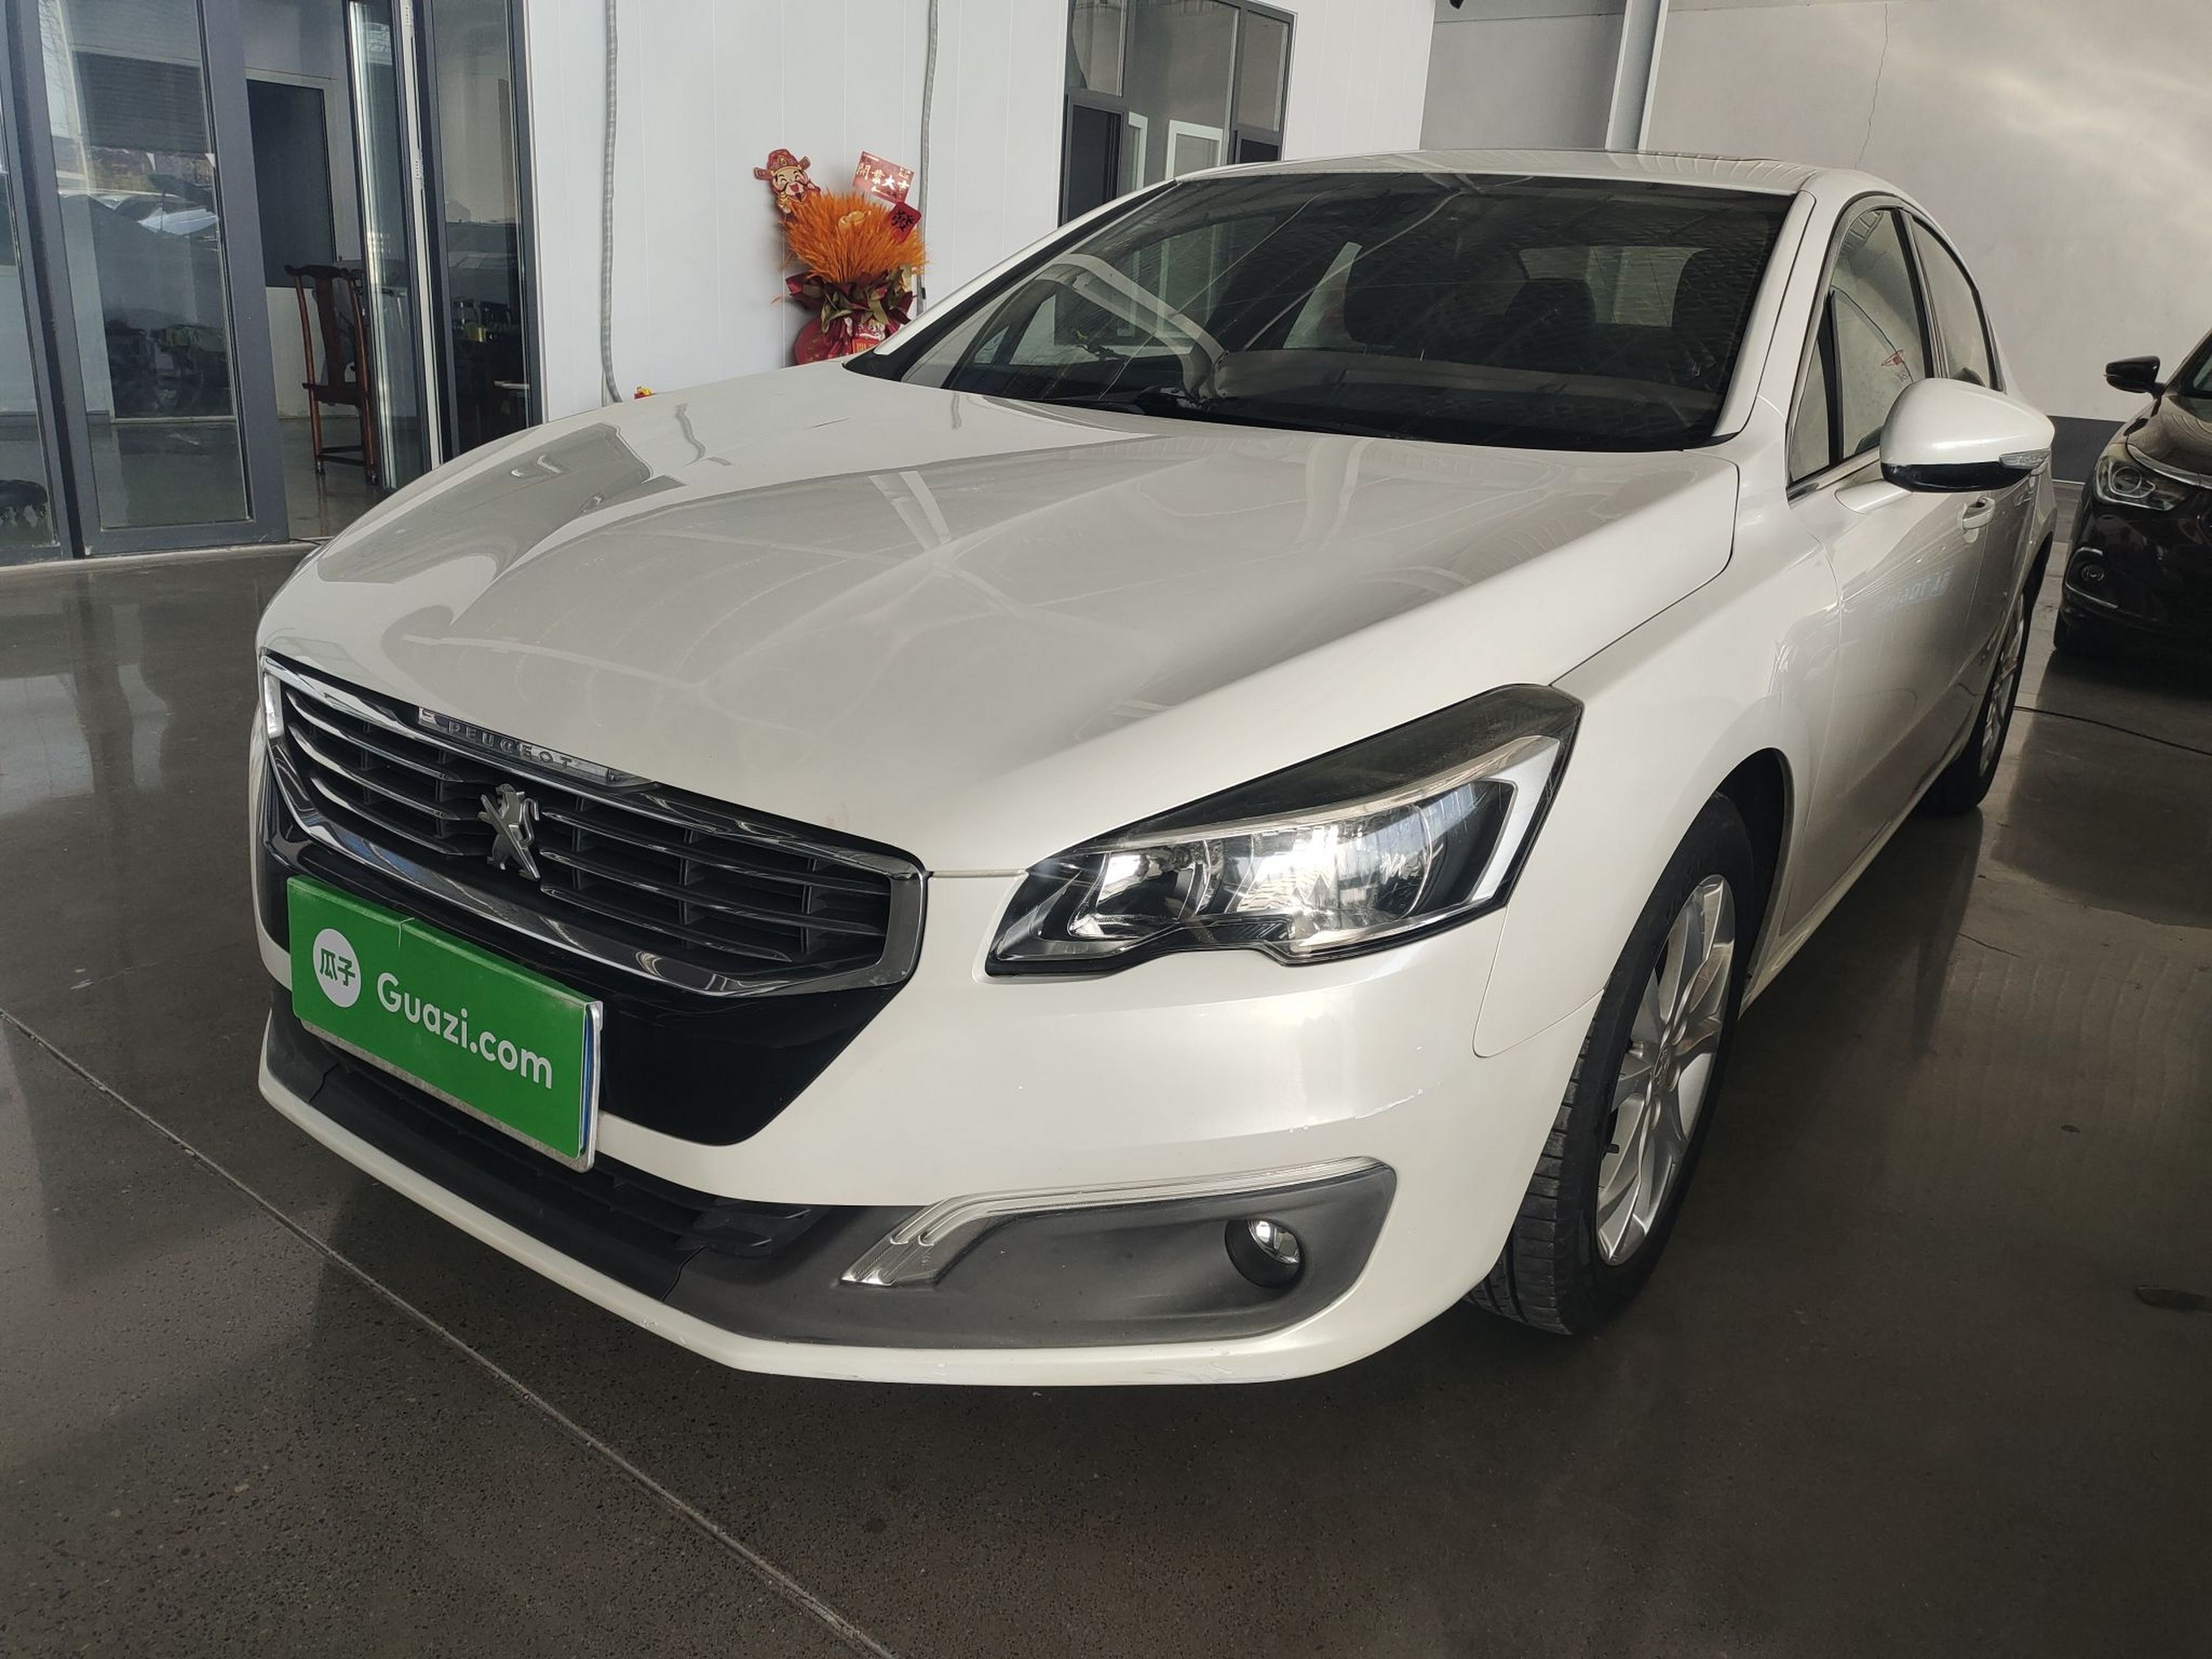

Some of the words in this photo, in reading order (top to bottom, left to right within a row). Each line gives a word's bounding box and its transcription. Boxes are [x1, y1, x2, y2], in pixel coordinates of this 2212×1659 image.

[448, 721, 572, 768] PEUGEOT
[319, 948, 355, 987] 瓜子
[377, 973, 552, 1089] Guazi.com
